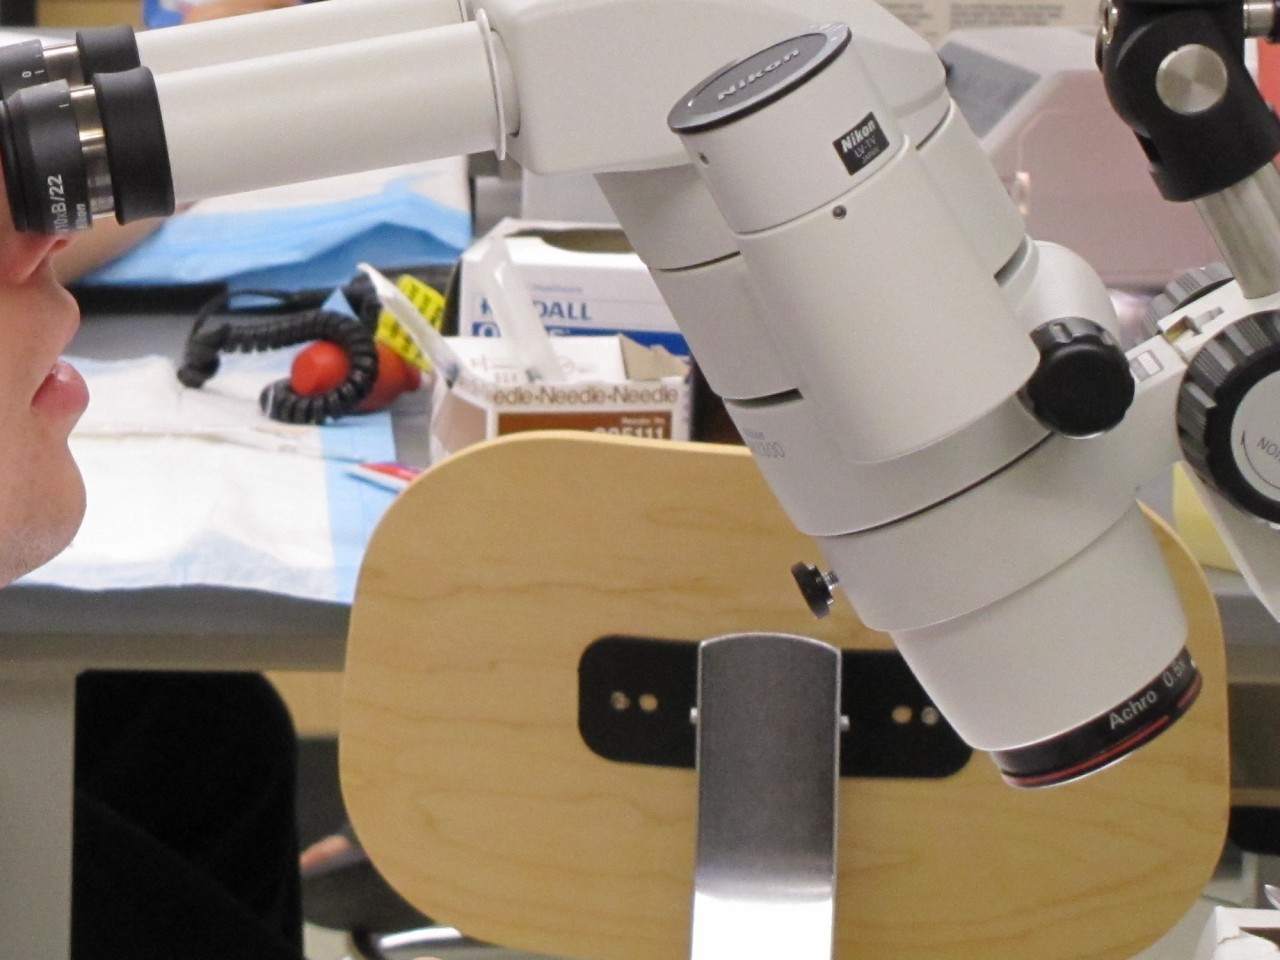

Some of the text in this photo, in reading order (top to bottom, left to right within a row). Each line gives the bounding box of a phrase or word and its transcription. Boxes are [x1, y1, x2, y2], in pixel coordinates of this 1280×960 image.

[717, 49, 800, 100] Nikon
[840, 119, 876, 153] Nikon
[1108, 690, 1158, 730] Achro
